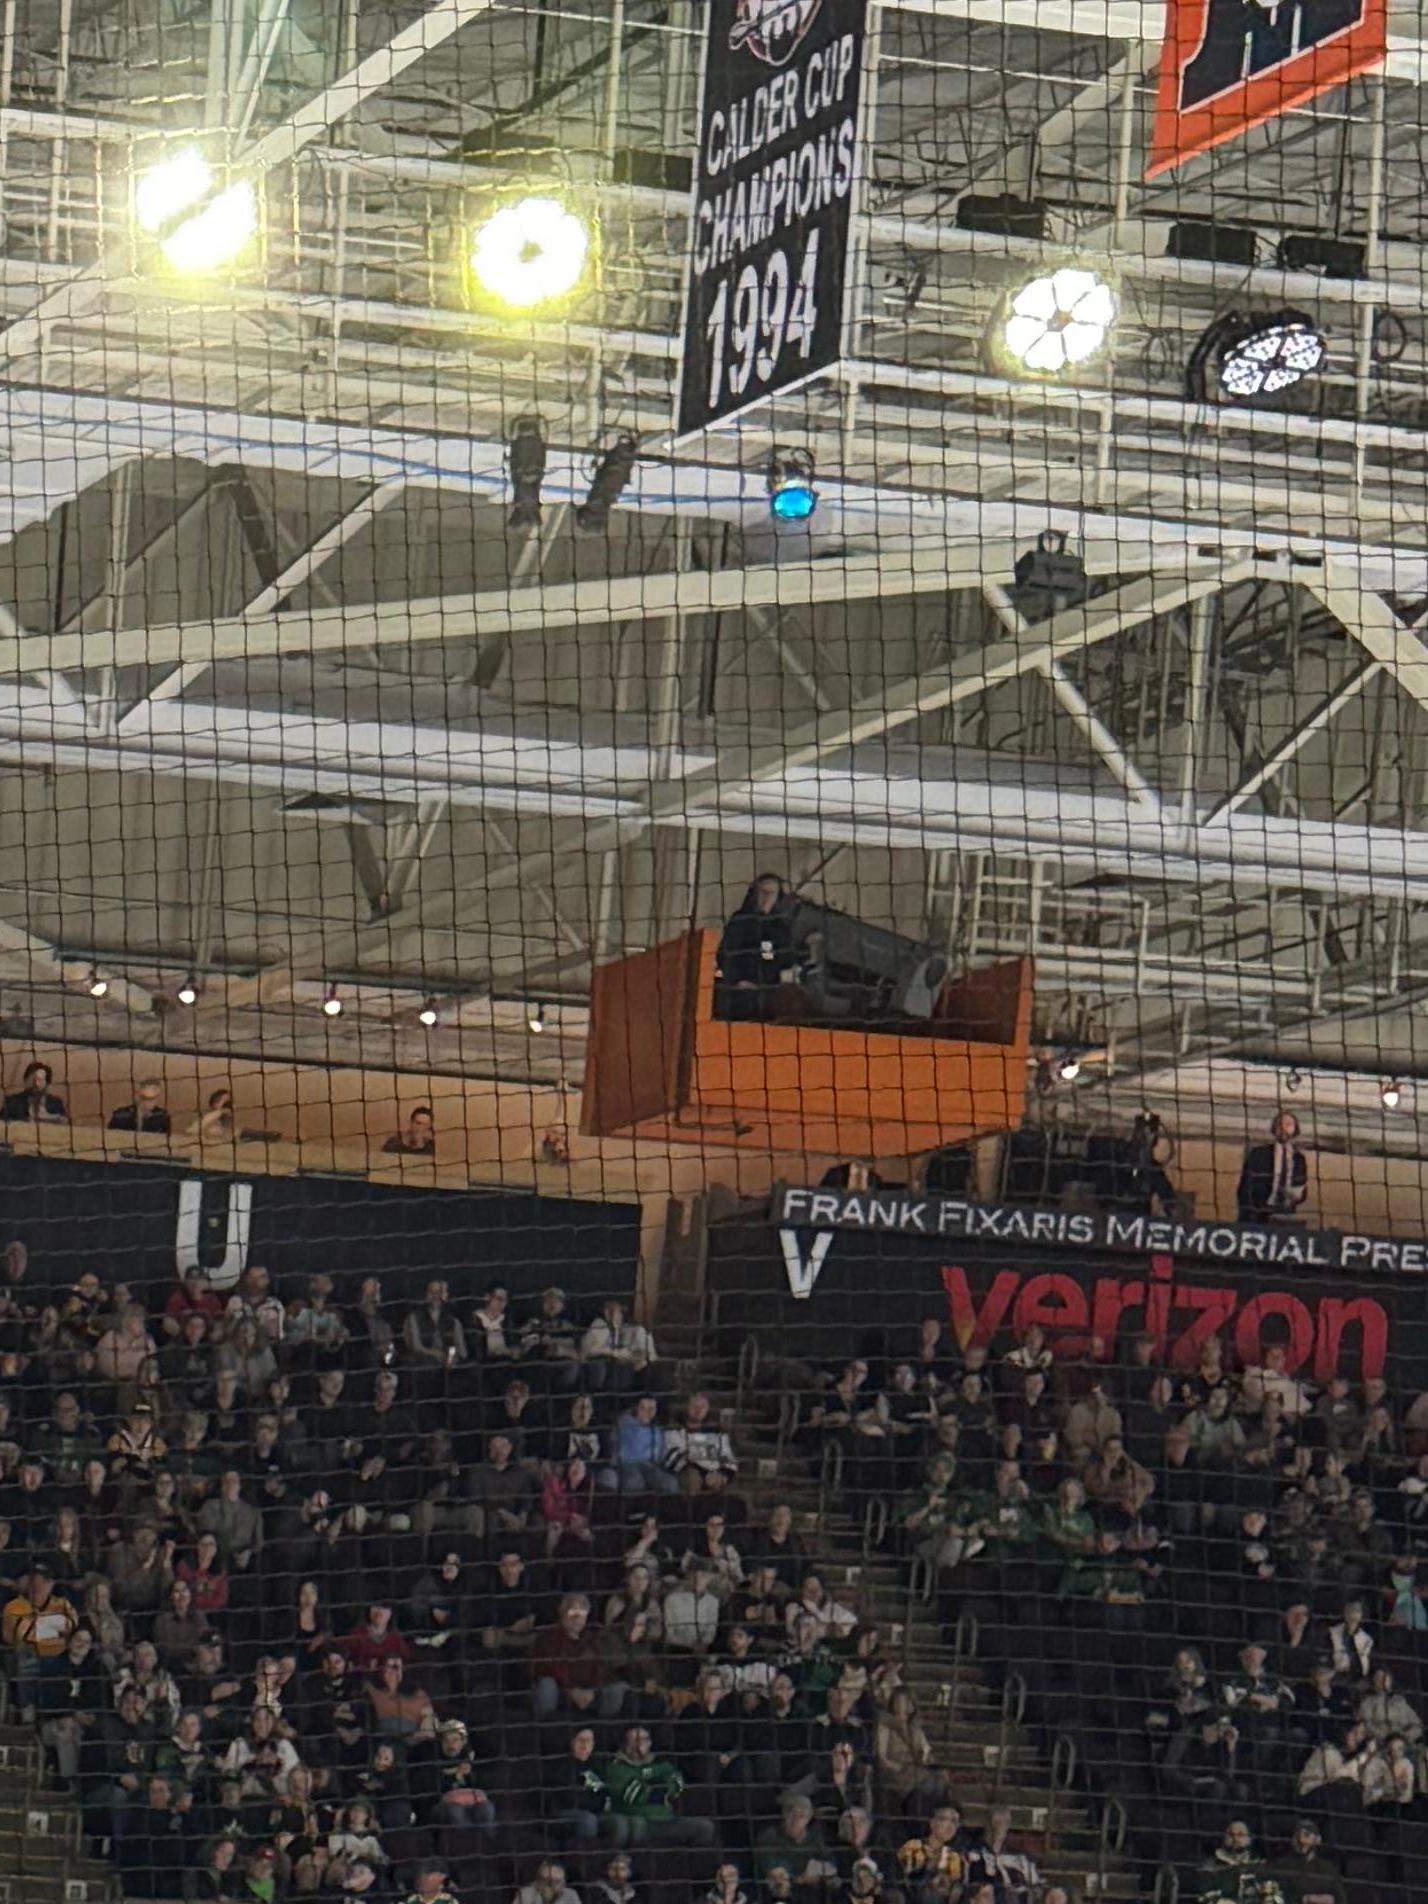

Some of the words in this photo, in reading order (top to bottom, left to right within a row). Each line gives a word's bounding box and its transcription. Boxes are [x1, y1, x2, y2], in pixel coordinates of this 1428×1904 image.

[706, 68, 799, 177] CALDER
[803, 33, 855, 120] CUP
[693, 117, 854, 277] CHAMPIONS
[706, 227, 820, 409] 1994
[177, 1180, 254, 1283] U
[779, 1229, 834, 1300] V
[783, 1188, 927, 1233] FRANK
[938, 1201, 1094, 1244] FIXARIS
[1105, 1214, 1328, 1267] MEMORIAL
[941, 1255, 1388, 1381] verizon
